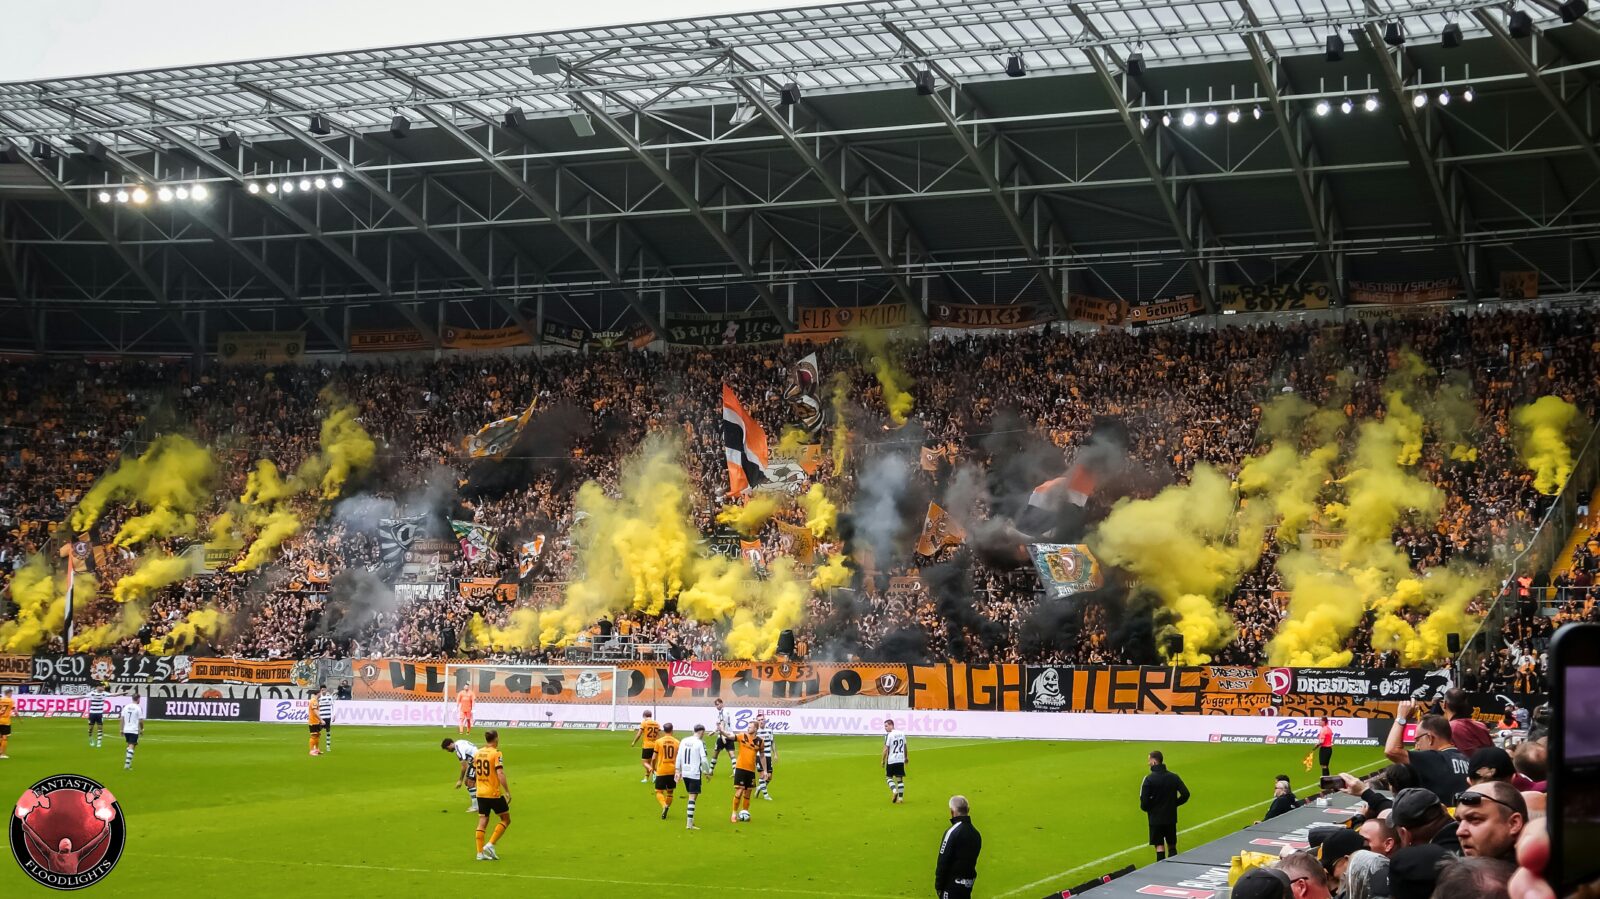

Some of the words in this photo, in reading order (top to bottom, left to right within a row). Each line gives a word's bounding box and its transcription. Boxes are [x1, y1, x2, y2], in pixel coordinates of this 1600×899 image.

[1146, 302, 1189, 316] Sebnitz
[1210, 666, 1259, 679] DRESDEN
[165, 702, 240, 717] RUNNING
[757, 709, 792, 717] ELEKTRO
[126, 711, 133, 723] 7
[1303, 718, 1344, 727] ELETRO
[647, 727, 659, 739] 25
[663, 745, 675, 760] 10
[892, 739, 904, 754] 22
[684, 748, 692, 765] 11
[476, 759, 491, 777] 39
